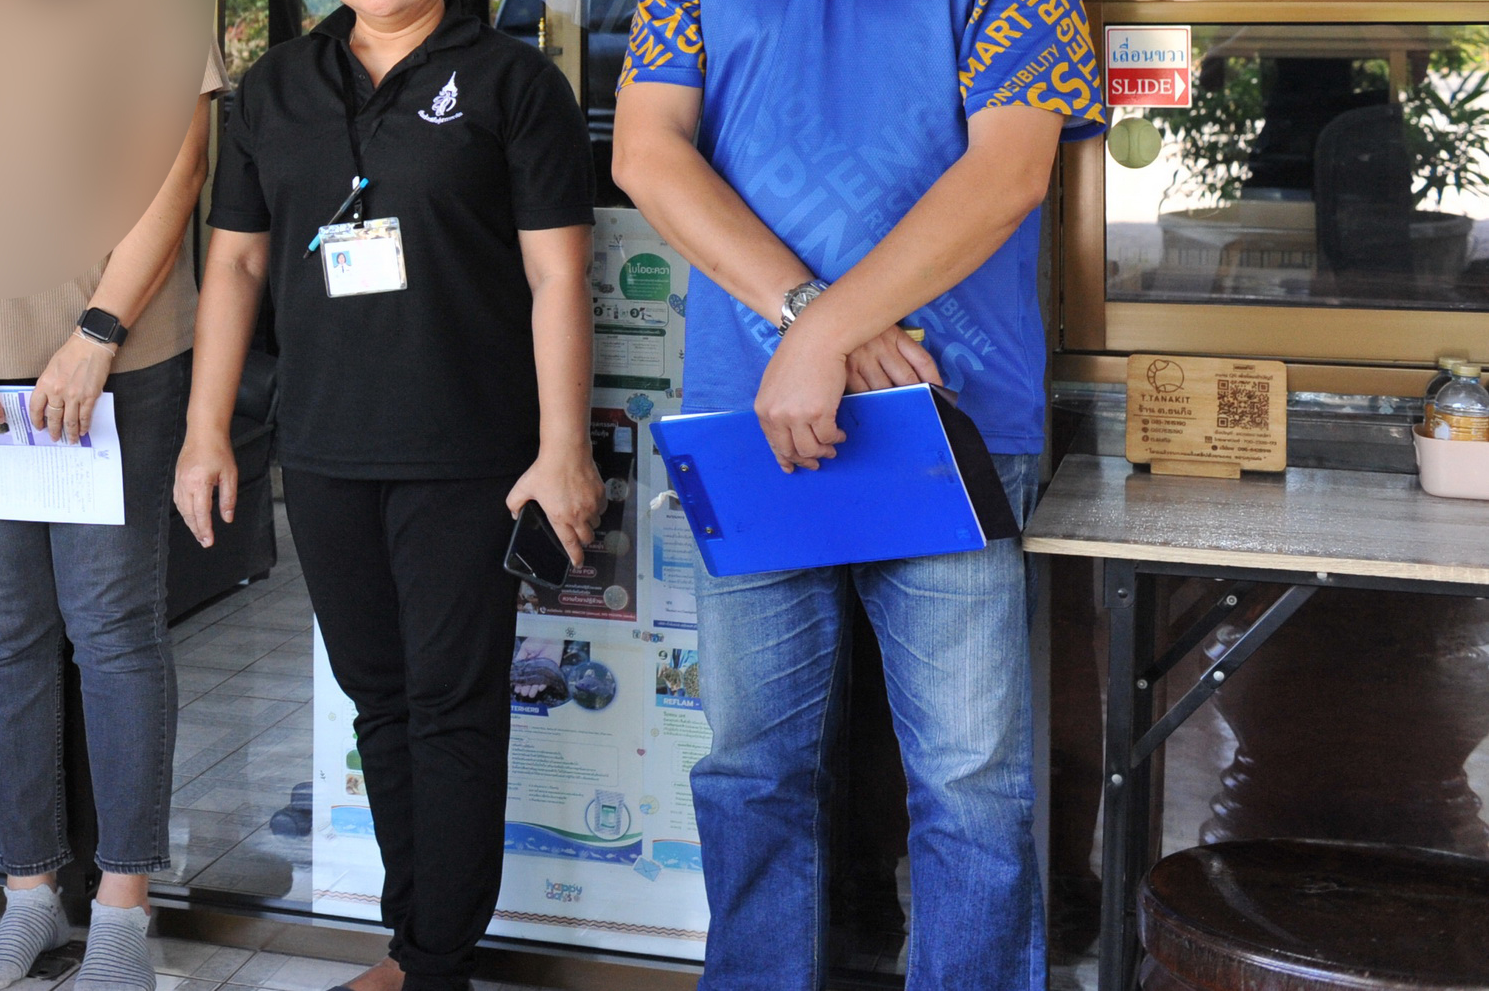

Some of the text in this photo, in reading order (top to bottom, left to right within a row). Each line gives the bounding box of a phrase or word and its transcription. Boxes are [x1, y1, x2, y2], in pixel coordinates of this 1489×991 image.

[1112, 36, 1185, 63] เลื่อนขวา
[980, 43, 1060, 112] ONSIBILITY
[1111, 78, 1173, 95] SLIDE
[1141, 394, 1191, 404] T.TANAKIT
[663, 697, 694, 708] REFLAM
